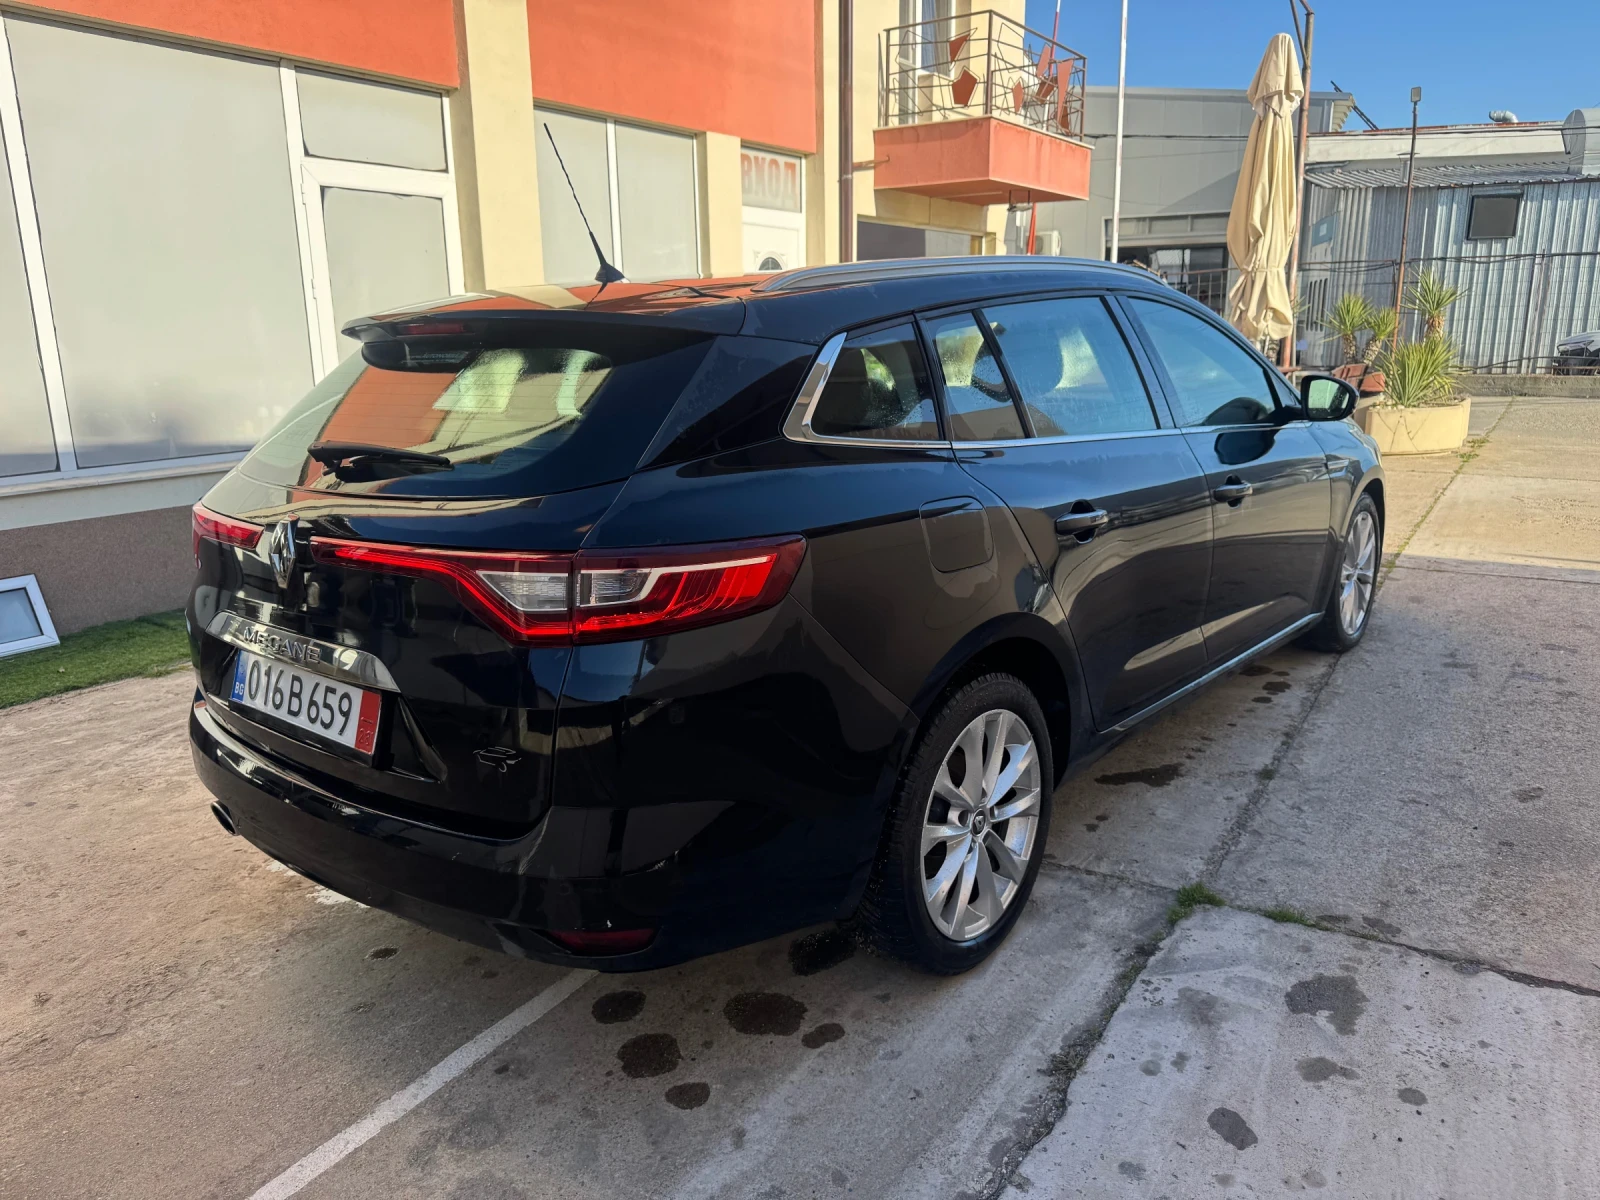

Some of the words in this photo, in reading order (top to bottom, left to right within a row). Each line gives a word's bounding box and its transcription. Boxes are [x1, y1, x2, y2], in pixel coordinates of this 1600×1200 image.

[741, 153, 798, 208] ВХОД
[243, 626, 321, 664] MEGANE
[234, 682, 245, 695] BG
[249, 660, 353, 736] 016B659
